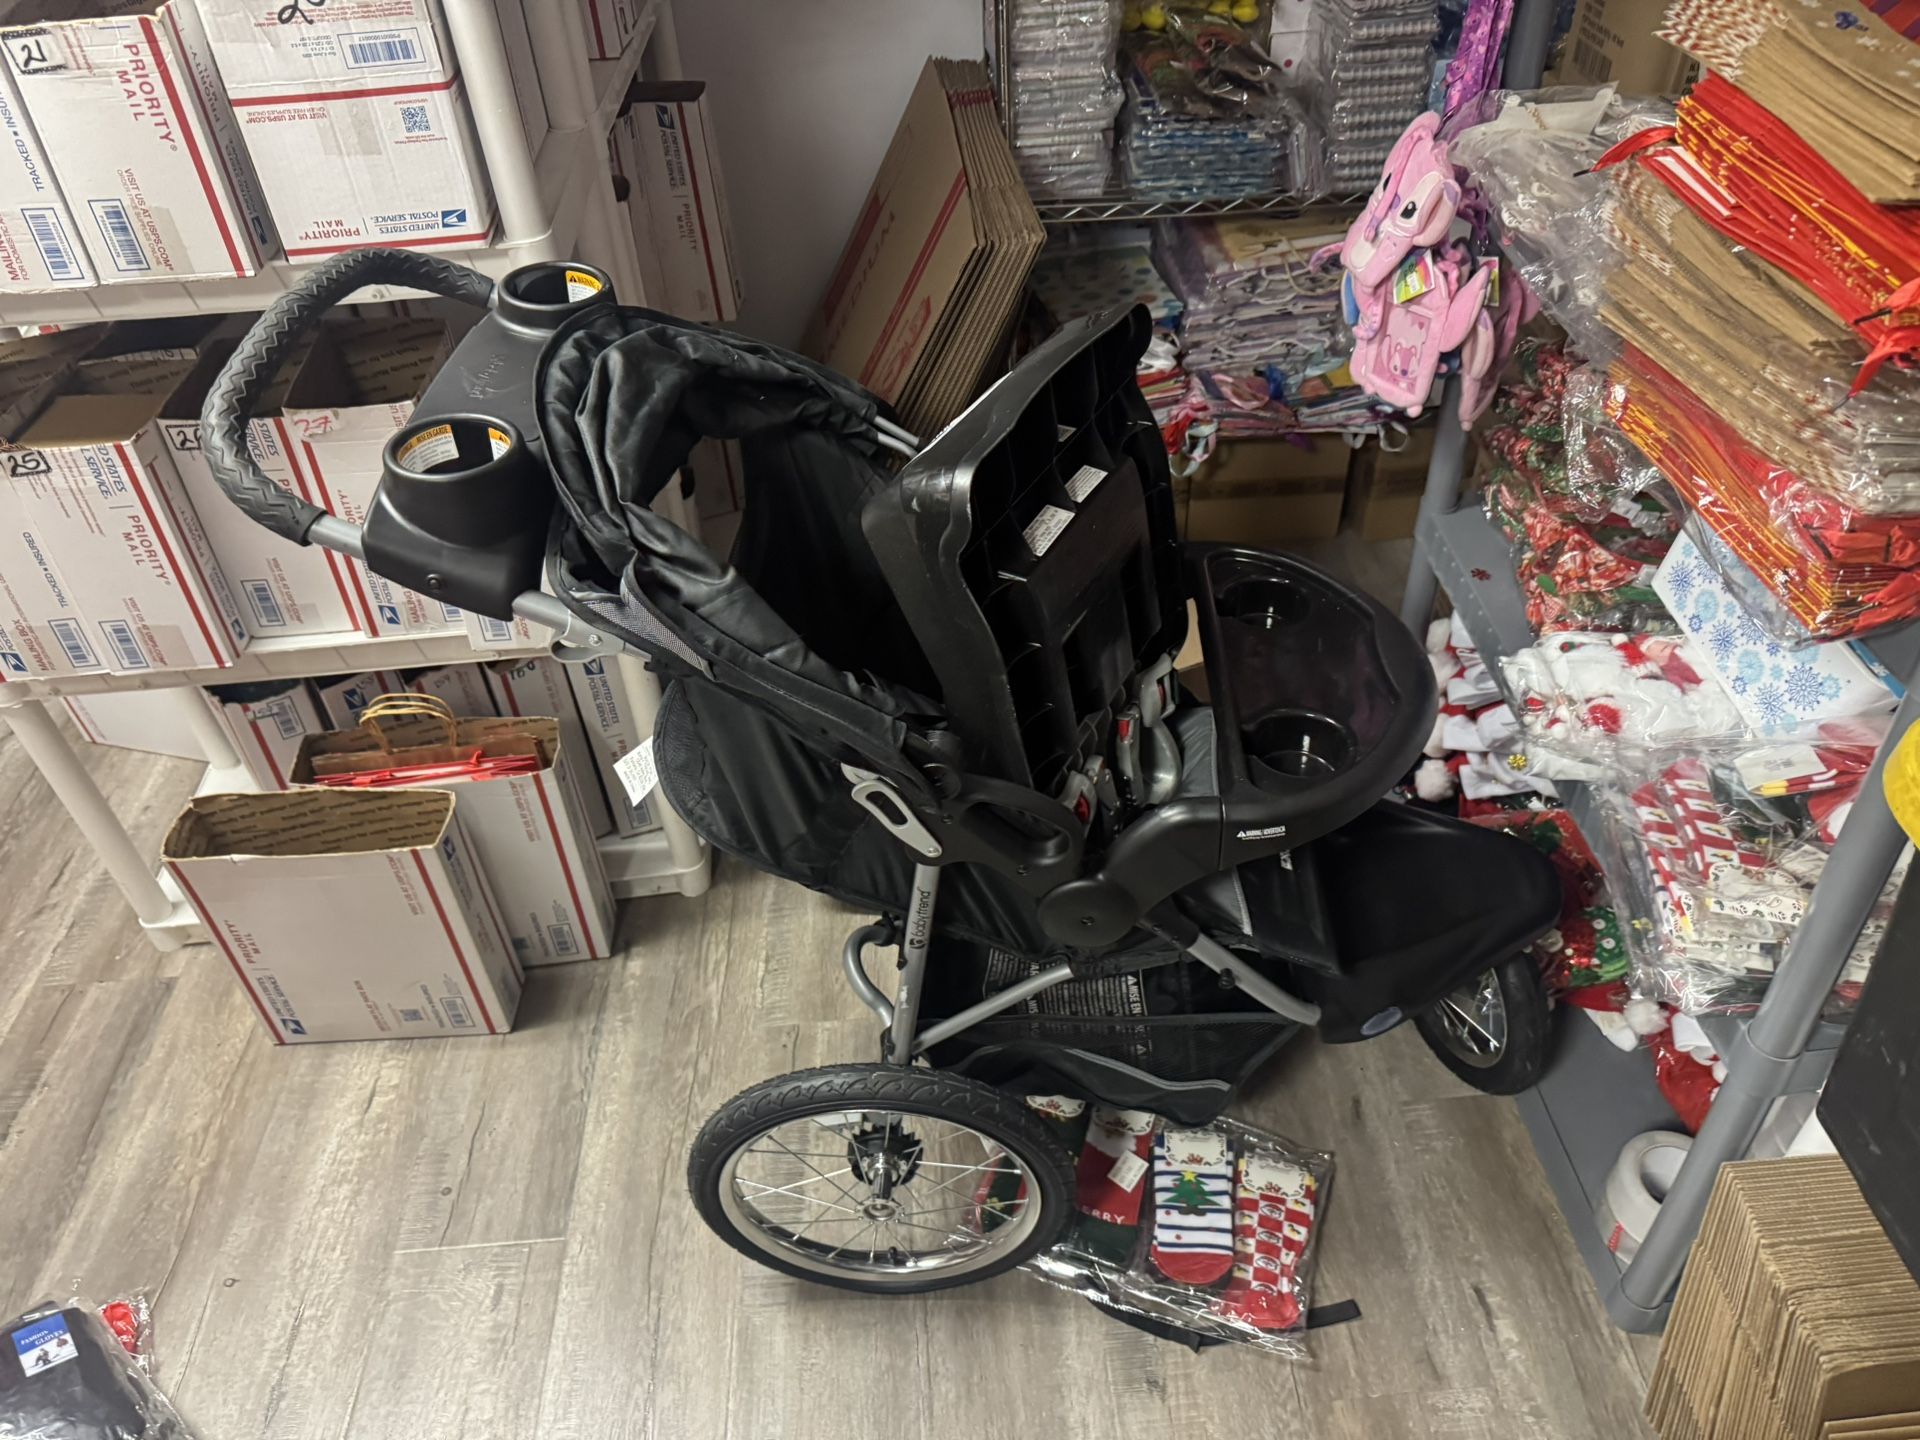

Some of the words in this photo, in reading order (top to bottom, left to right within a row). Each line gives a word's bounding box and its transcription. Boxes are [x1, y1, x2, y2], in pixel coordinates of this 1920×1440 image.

[21, 39, 48, 69] 21
[117, 69, 145, 122] MAIL
[0, 90, 17, 129] INSU
[287, 113, 297, 121] AT
[297, 112, 308, 120] US
[308, 111, 327, 119] VISIT
[669, 131, 683, 158] UNITED
[14, 138, 45, 192] TRACKED
[124, 168, 139, 190] VISIT
[135, 191, 145, 206] US
[139, 207, 151, 220] AT
[313, 219, 344, 229] MAIL
[408, 210, 439, 221] POSTAL
[379, 222, 409, 235] STATES
[408, 221, 441, 234] UNITED
[676, 214, 687, 239] MAIL
[682, 203, 699, 250] PRIORITY
[0, 225, 22, 264] DOMESTIC
[18, 266, 28, 280] FOR
[258, 422, 280, 457] STATES
[8, 451, 43, 477] 25
[104, 456, 128, 493] STATES
[23, 532, 45, 567] INSURED
[122, 531, 143, 567] MAIL
[45, 573, 67, 608] TRACKED
[367, 578, 381, 603] UNITED
[380, 581, 393, 603] POSTAL
[128, 596, 141, 613] VISIT
[136, 612, 146, 622] US
[141, 622, 151, 631] AT
[402, 591, 419, 622] MAILING
[11, 618, 27, 637] BOX
[21, 636, 48, 672] MAILING
[587, 676, 601, 703] POSTAL
[599, 675, 613, 704] UNITED
[608, 700, 620, 725] STATES
[244, 932, 262, 956] MAIL
[1128, 985, 1140, 1002] MISE
[1131, 1002, 1142, 1014] EN
[1078, 1206, 1126, 1225] ERRY
